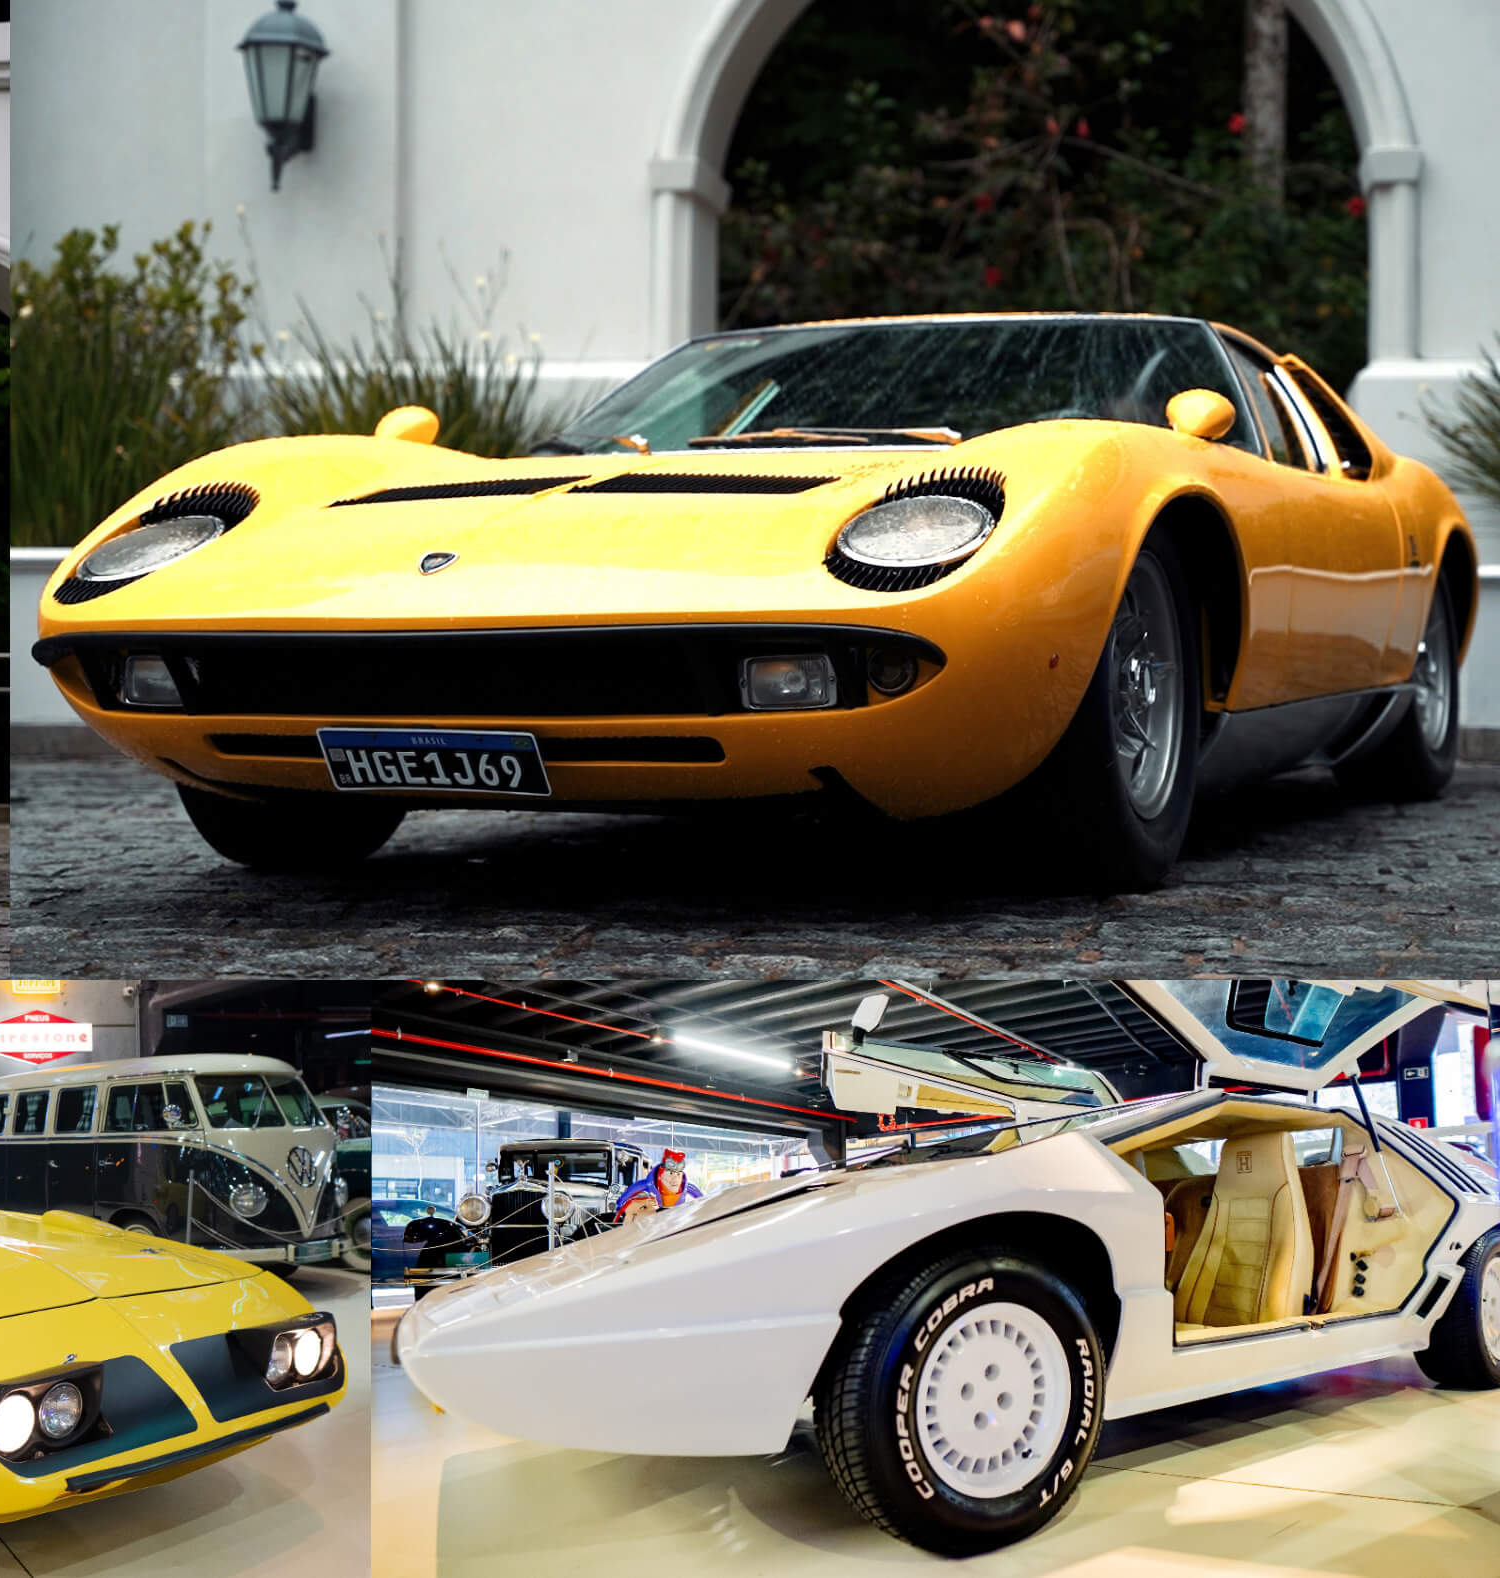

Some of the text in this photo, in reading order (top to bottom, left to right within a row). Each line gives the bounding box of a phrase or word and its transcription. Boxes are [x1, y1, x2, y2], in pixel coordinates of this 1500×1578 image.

[411, 736, 447, 746] BRASIL
[346, 750, 522, 788] HGE1J69
[24, 1014, 50, 1023] PNEUS
[914, 1277, 995, 1352] COBRA
[1075, 1338, 1095, 1446] RADIAL
[896, 1363, 935, 1500] COOPER
[1039, 1458, 1075, 1508] G/T
